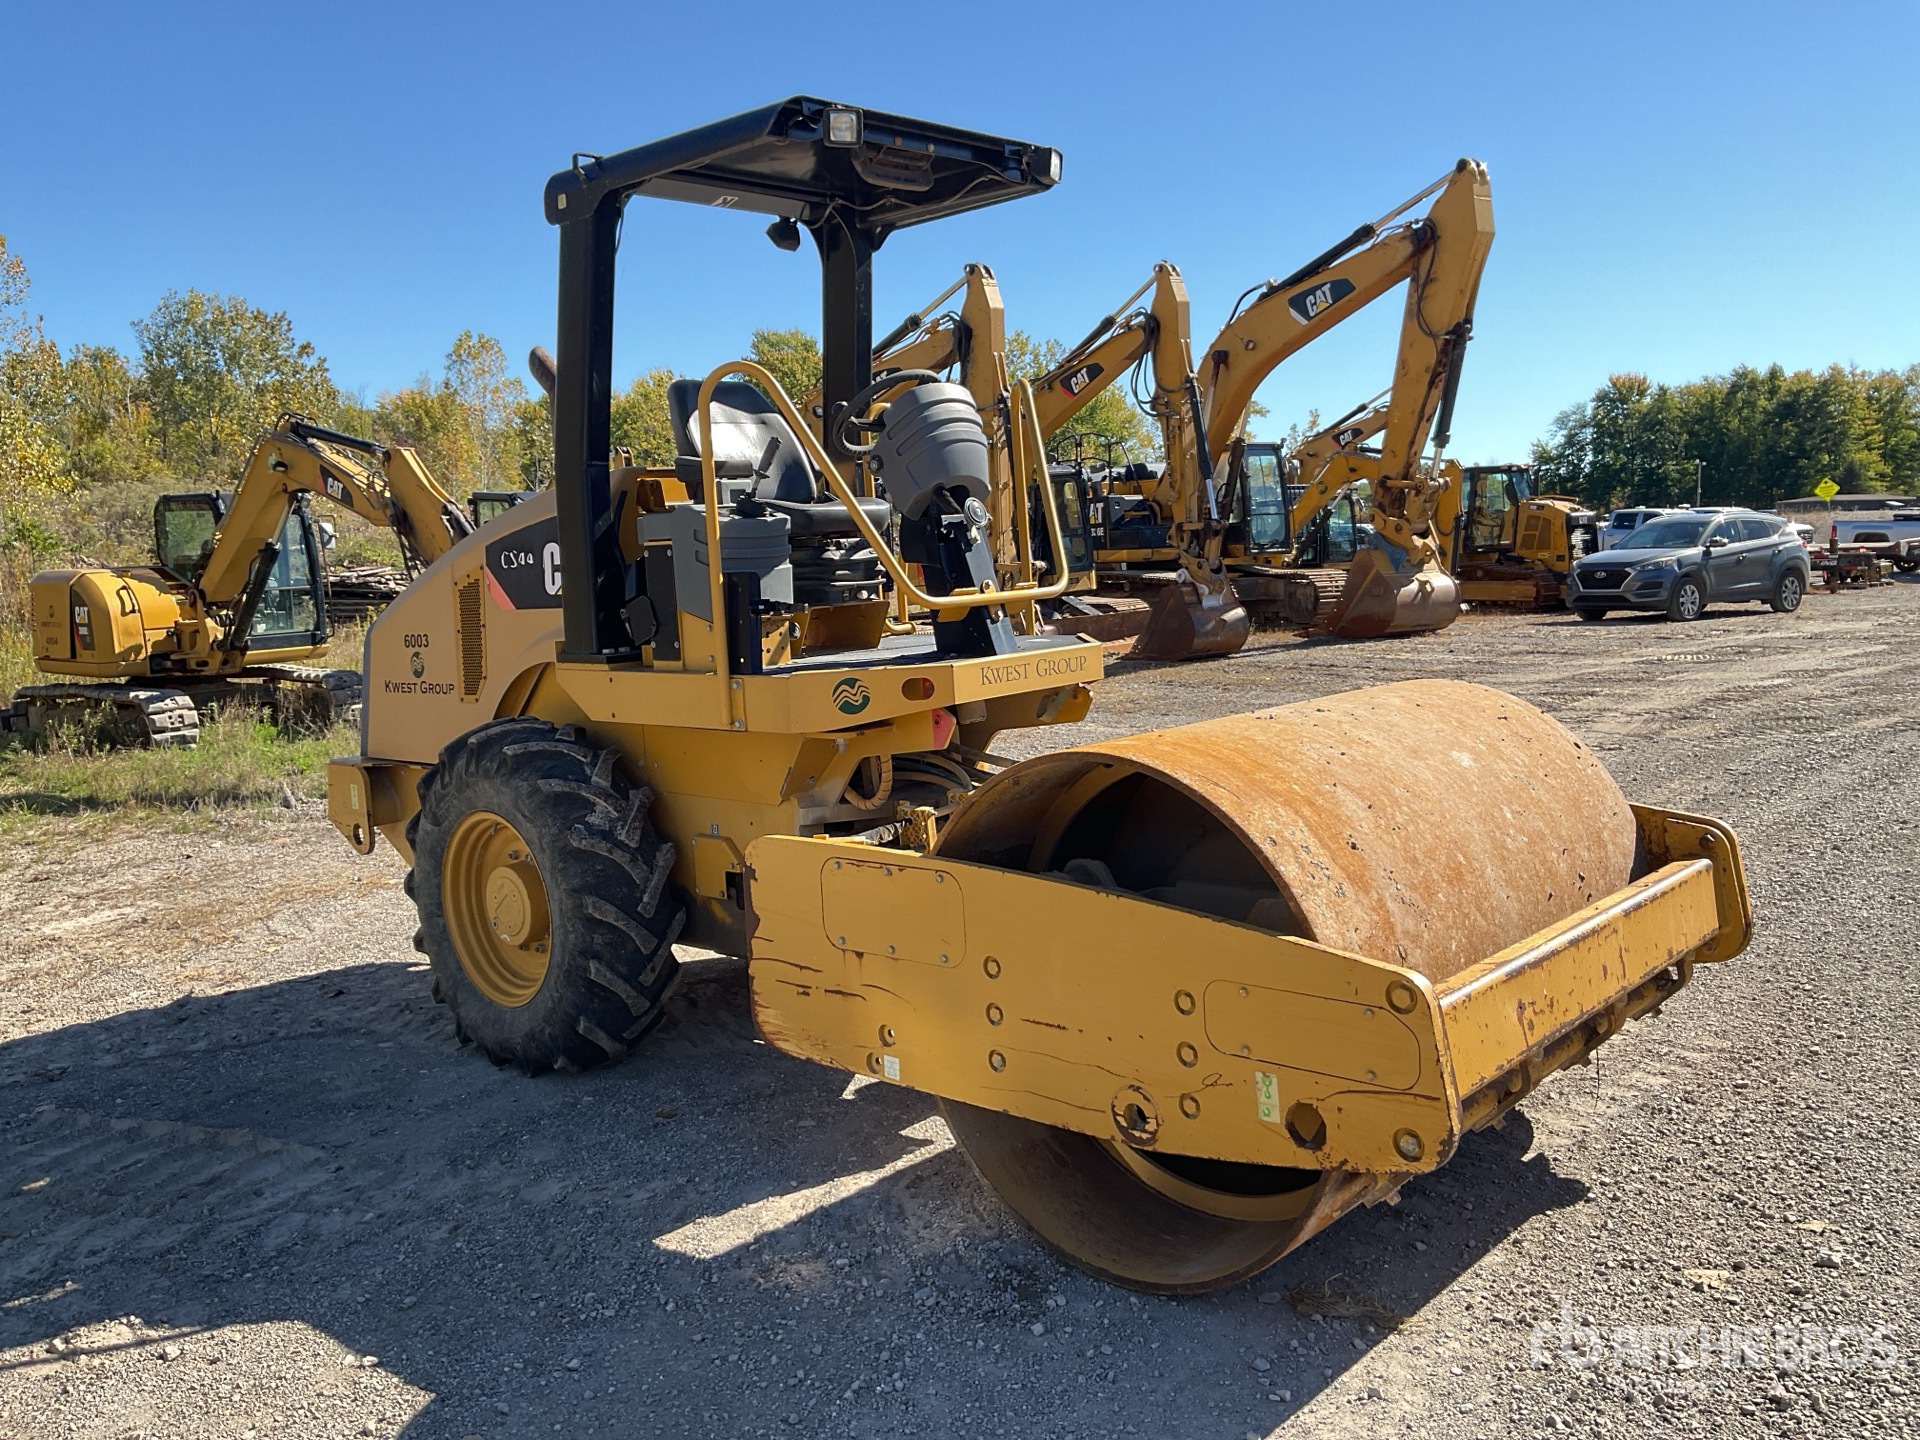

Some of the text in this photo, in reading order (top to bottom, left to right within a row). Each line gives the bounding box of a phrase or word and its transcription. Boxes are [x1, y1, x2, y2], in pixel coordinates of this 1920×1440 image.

[1305, 282, 1333, 317] CAT
[1070, 367, 1090, 394] CAT
[1339, 429, 1353, 446] CAT
[327, 477, 344, 500] CAT
[1089, 502, 1104, 525] AT
[74, 606, 89, 624] CAT
[404, 633, 430, 649] 6003
[980, 655, 1087, 686] KWEST GROUP
[384, 679, 455, 695] KWEST GROUP
